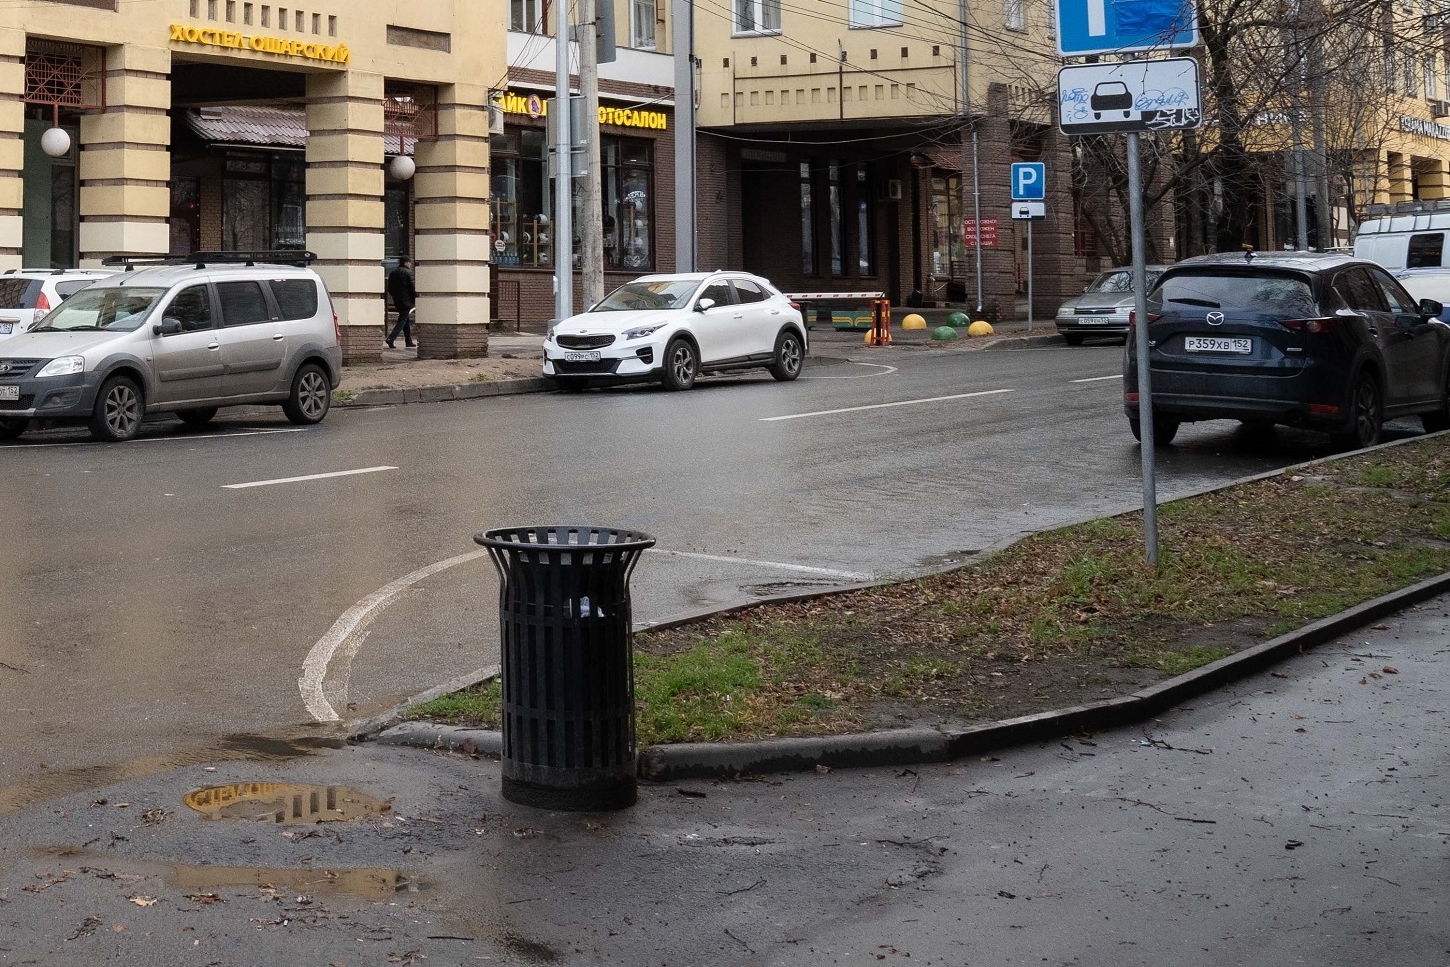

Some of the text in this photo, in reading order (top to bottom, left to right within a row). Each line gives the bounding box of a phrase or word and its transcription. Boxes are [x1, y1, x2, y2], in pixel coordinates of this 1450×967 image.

[170, 24, 350, 63] ХОСТЕЛ ОШАРСКИЙ
[598, 106, 667, 130] ОТОСАЛОН
[1018, 167, 1037, 195] P
[1188, 338, 1249, 350] Р359ХВ 152
